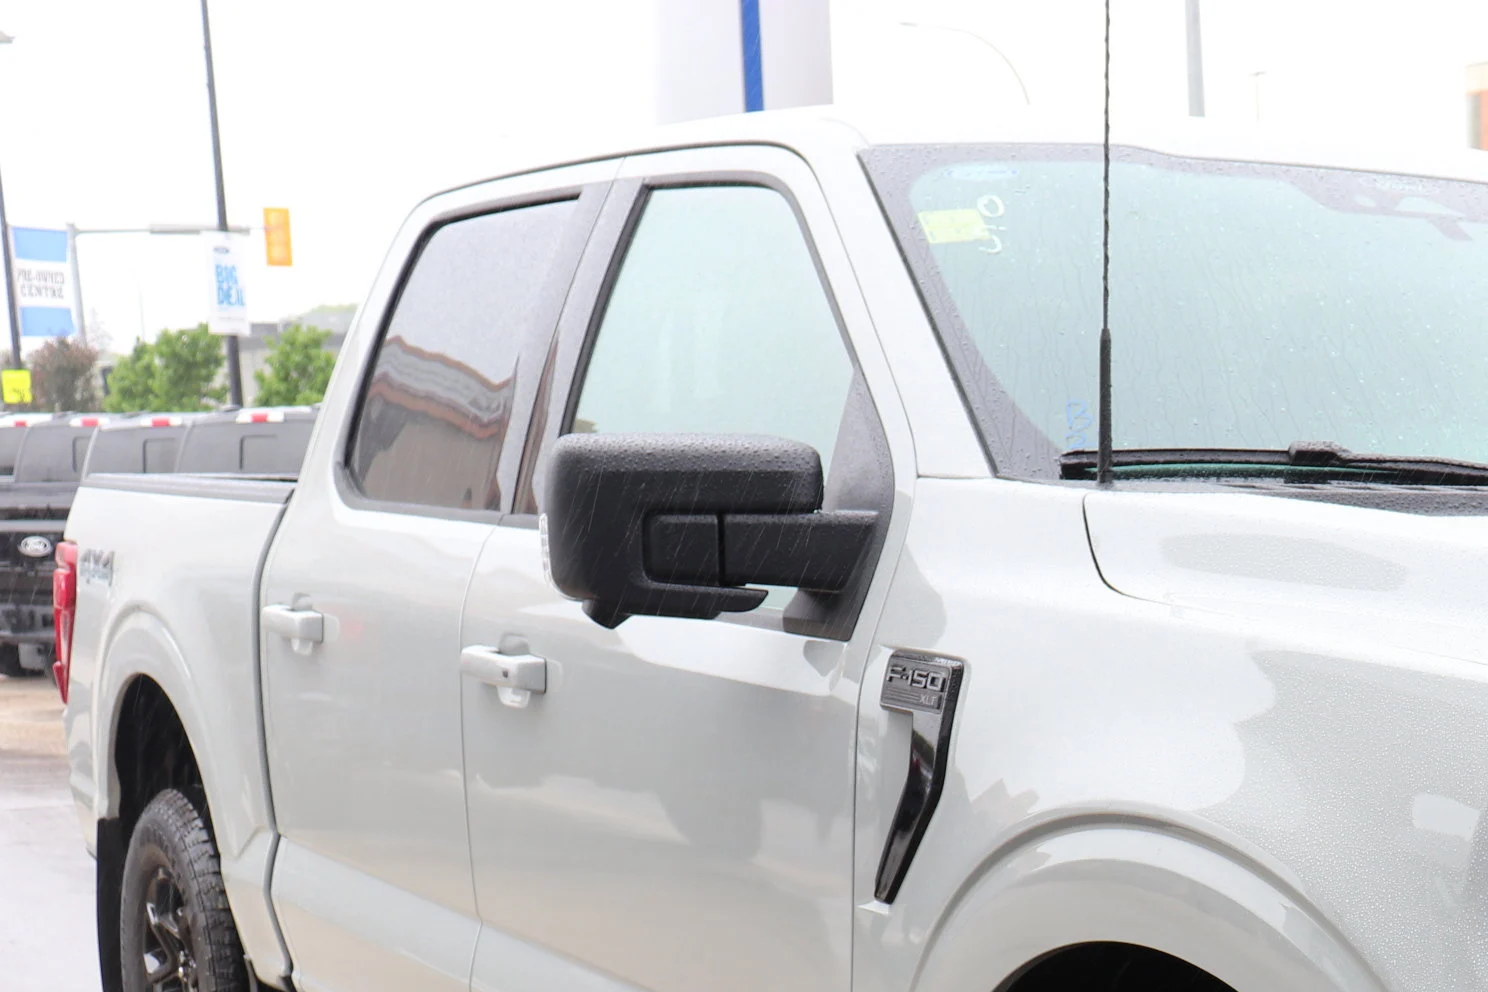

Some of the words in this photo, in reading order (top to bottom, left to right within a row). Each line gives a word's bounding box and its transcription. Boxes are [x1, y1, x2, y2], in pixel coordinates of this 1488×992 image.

[20, 283, 64, 300] CENTRE
[886, 664, 945, 692] F-150
[920, 694, 938, 706] XLT
